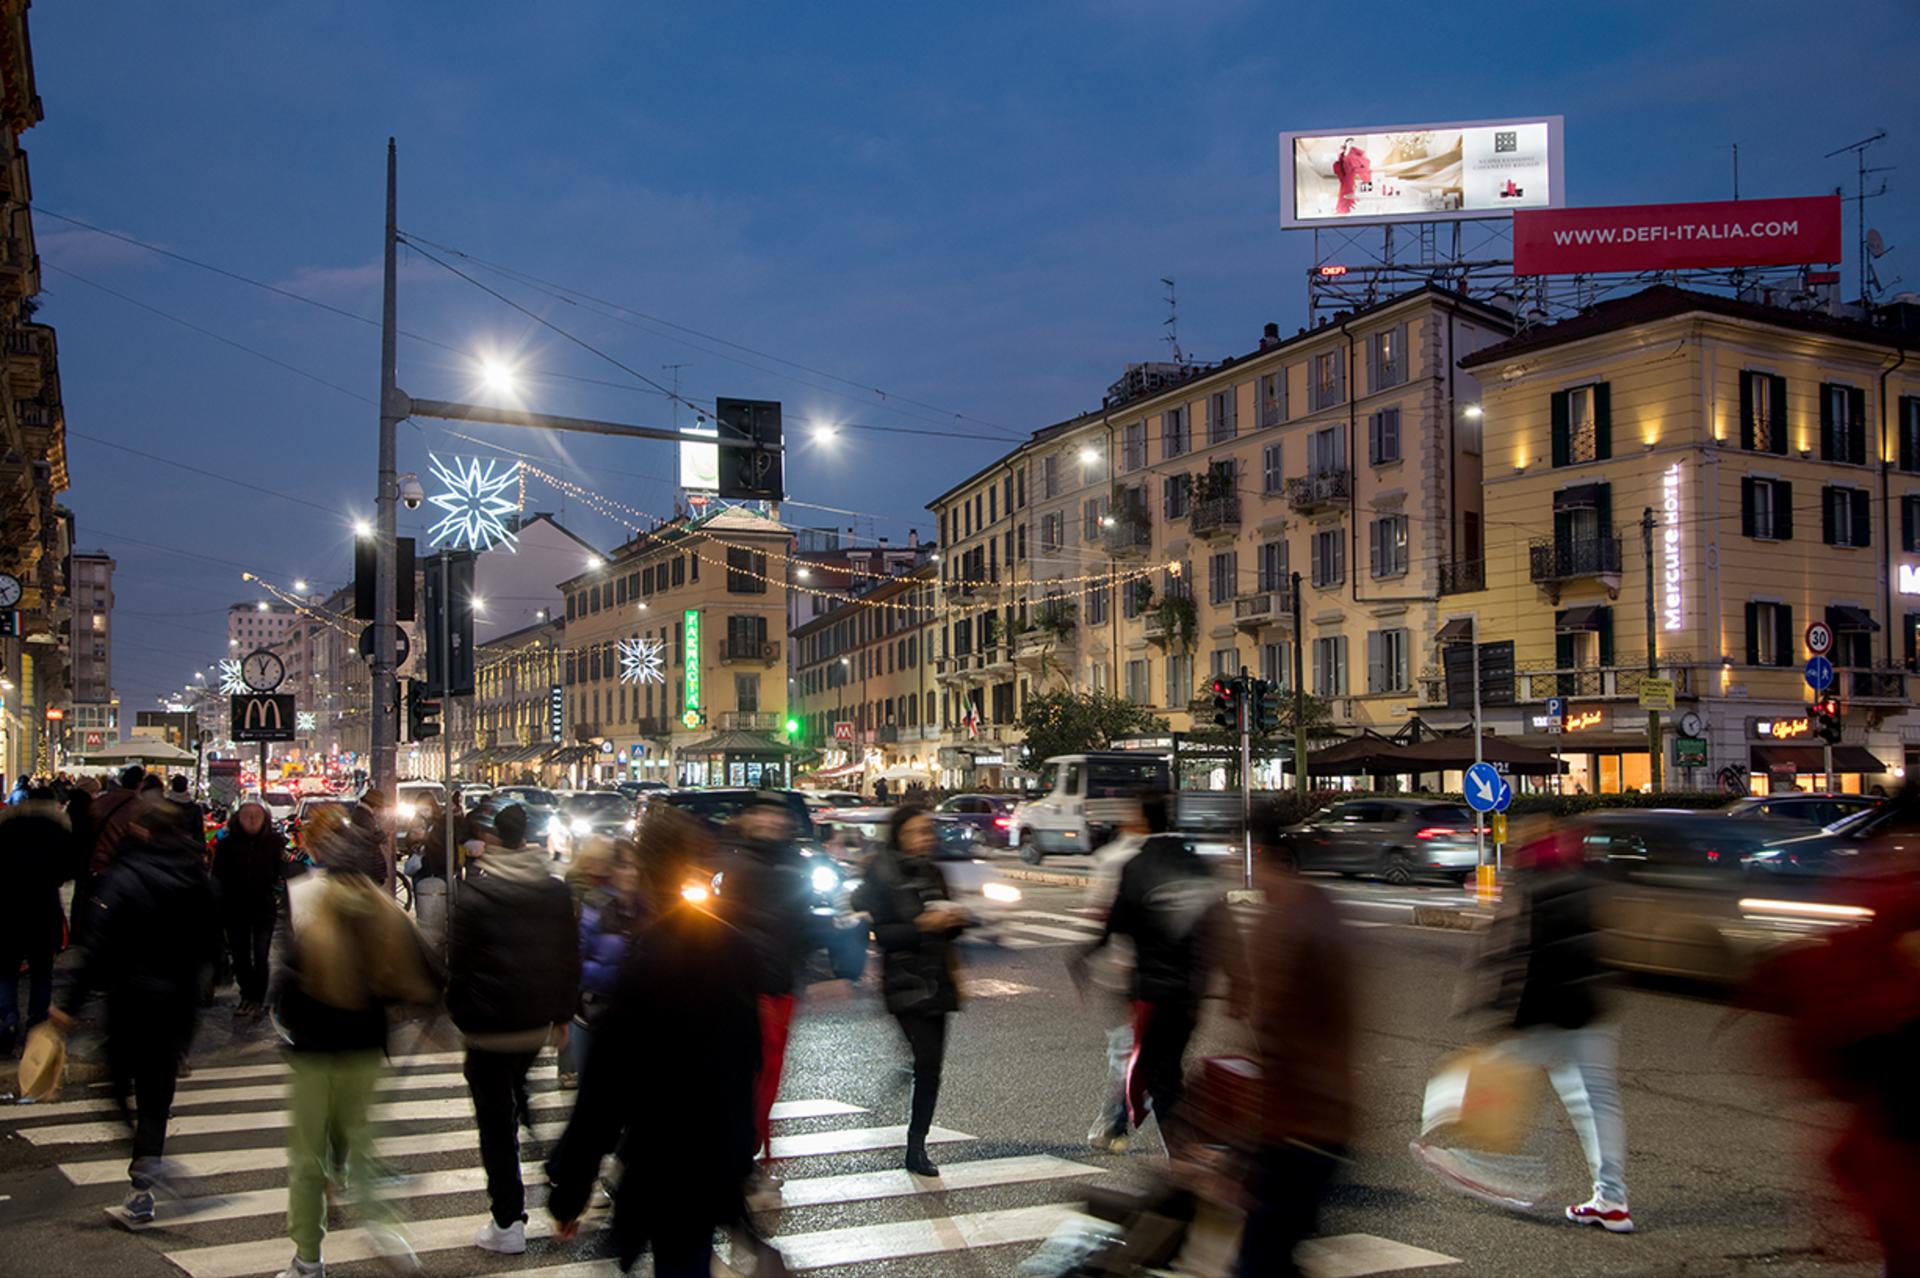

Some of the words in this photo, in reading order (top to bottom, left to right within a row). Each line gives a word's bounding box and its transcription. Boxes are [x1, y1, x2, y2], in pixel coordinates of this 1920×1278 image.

[1554, 221, 1799, 246] WWW.DEFI-ITALIA.COM
[1664, 463, 1679, 525] HOTEL
[1664, 528, 1681, 630] Mercure
[1812, 630, 1827, 646] 30
[686, 615, 698, 705] FARMACIA
[1549, 700, 1559, 715] P
